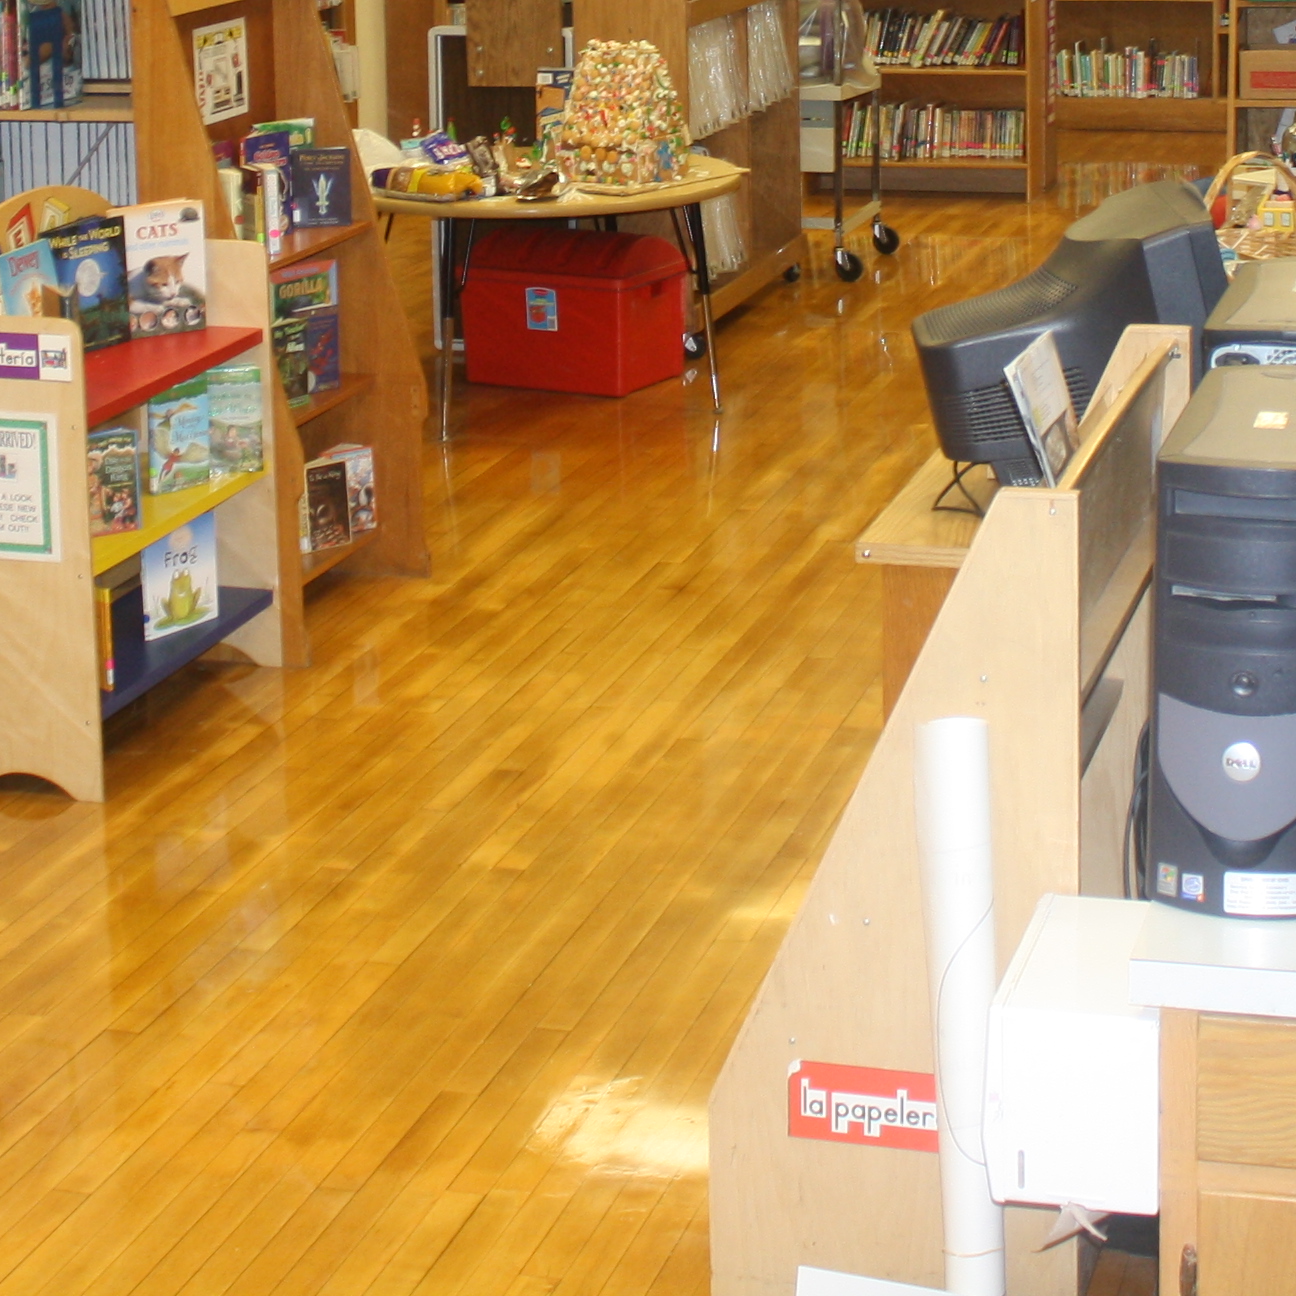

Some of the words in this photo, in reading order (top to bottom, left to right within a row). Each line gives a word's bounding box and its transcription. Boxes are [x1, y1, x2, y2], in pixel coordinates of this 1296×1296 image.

[49, 233, 77, 248] WHILE
[88, 225, 121, 241] WORLD
[136, 223, 178, 240] CATS
[69, 242, 110, 260] SLEEPING
[7, 252, 40, 277] Dewey
[279, 277, 324, 299] GORILLA
[1, 492, 7, 500] A
[10, 493, 32, 502] LOOK
[17, 504, 36, 513] NEW
[10, 513, 38, 523] CHECK
[164, 546, 199, 568] Frog
[1226, 757, 1257, 769] DELL
[803, 1086, 823, 1114] la
[835, 1095, 935, 1134] papeler
